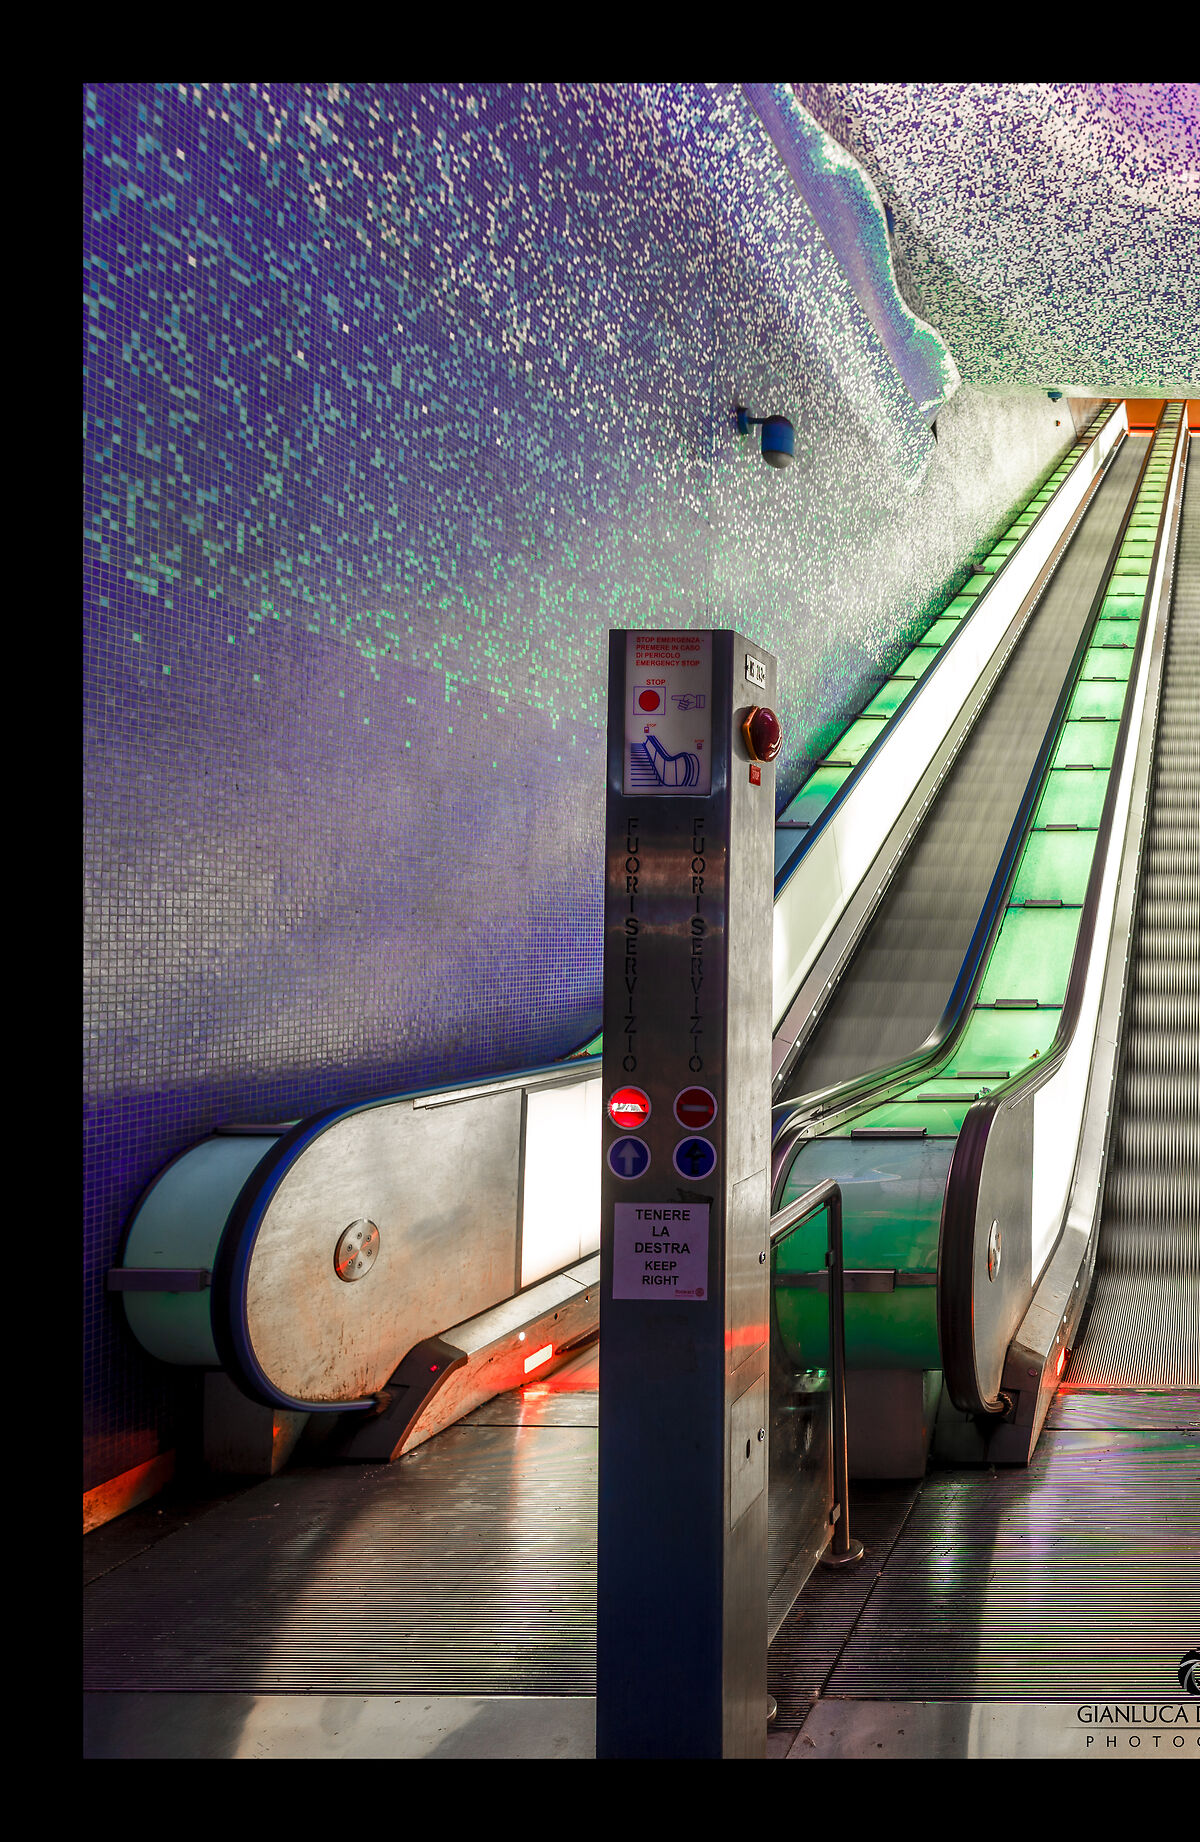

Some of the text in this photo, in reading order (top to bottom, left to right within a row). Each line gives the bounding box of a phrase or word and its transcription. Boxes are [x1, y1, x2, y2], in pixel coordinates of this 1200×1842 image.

[622, 818, 640, 1073] FUORI SERVIZIO
[689, 818, 706, 1073] FUORI SERVIZIO
[636, 1210, 691, 1220] TENERE
[652, 1226, 670, 1237] LA
[634, 1242, 690, 1254] DESTRA
[645, 1261, 677, 1270] KEEP
[642, 1276, 679, 1286] RIGHT
